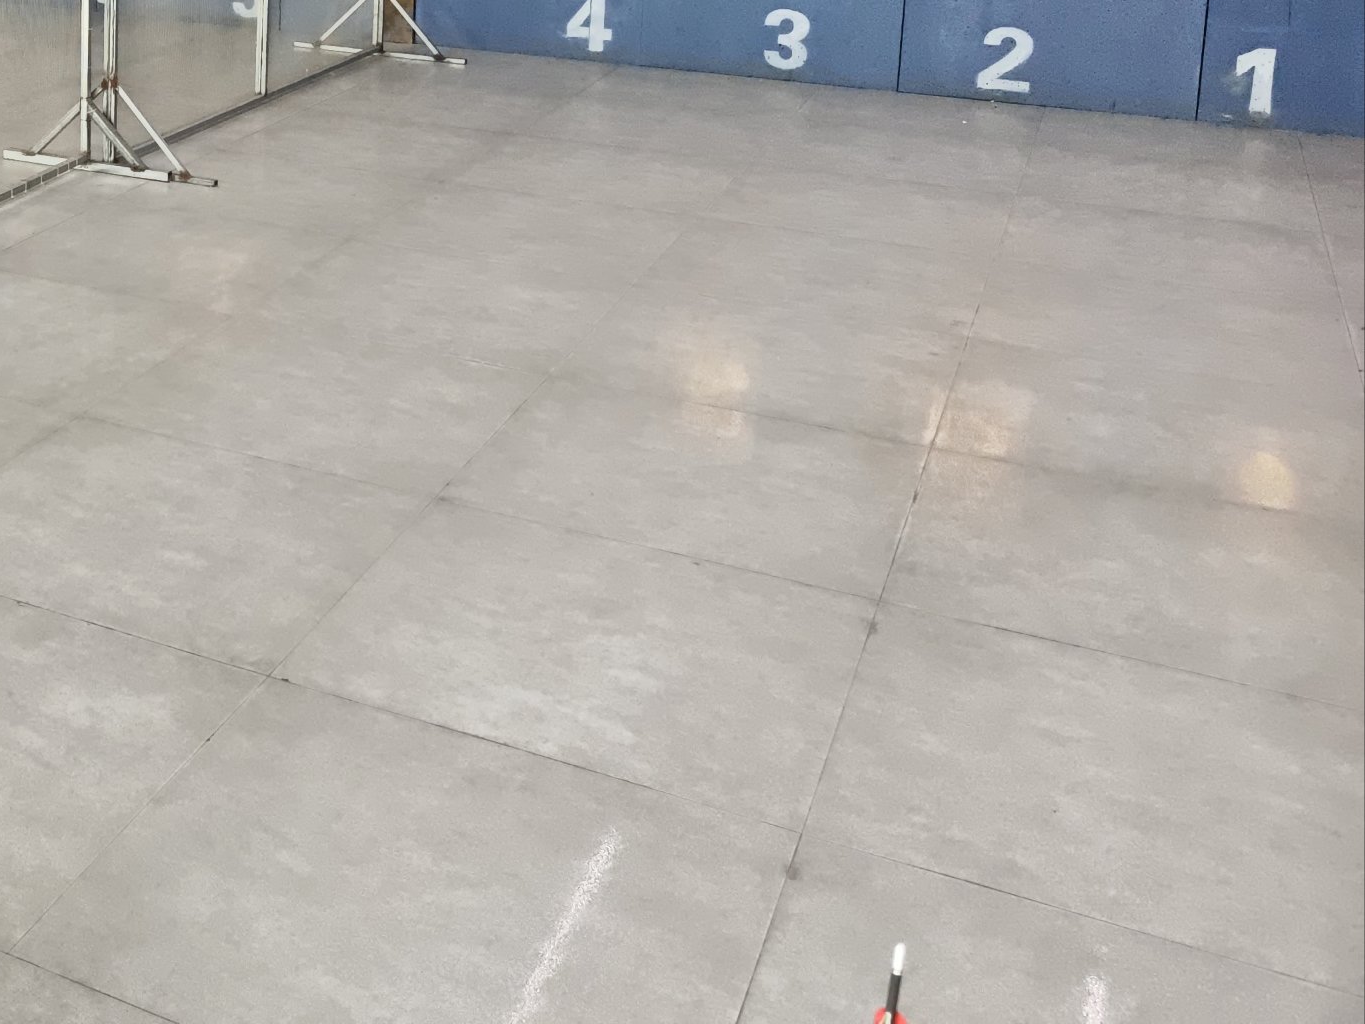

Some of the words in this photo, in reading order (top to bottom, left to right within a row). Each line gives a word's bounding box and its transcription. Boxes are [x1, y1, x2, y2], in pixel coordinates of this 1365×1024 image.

[763, 8, 811, 71] 3
[976, 26, 1035, 94] 2
[1236, 47, 1278, 120] 1
